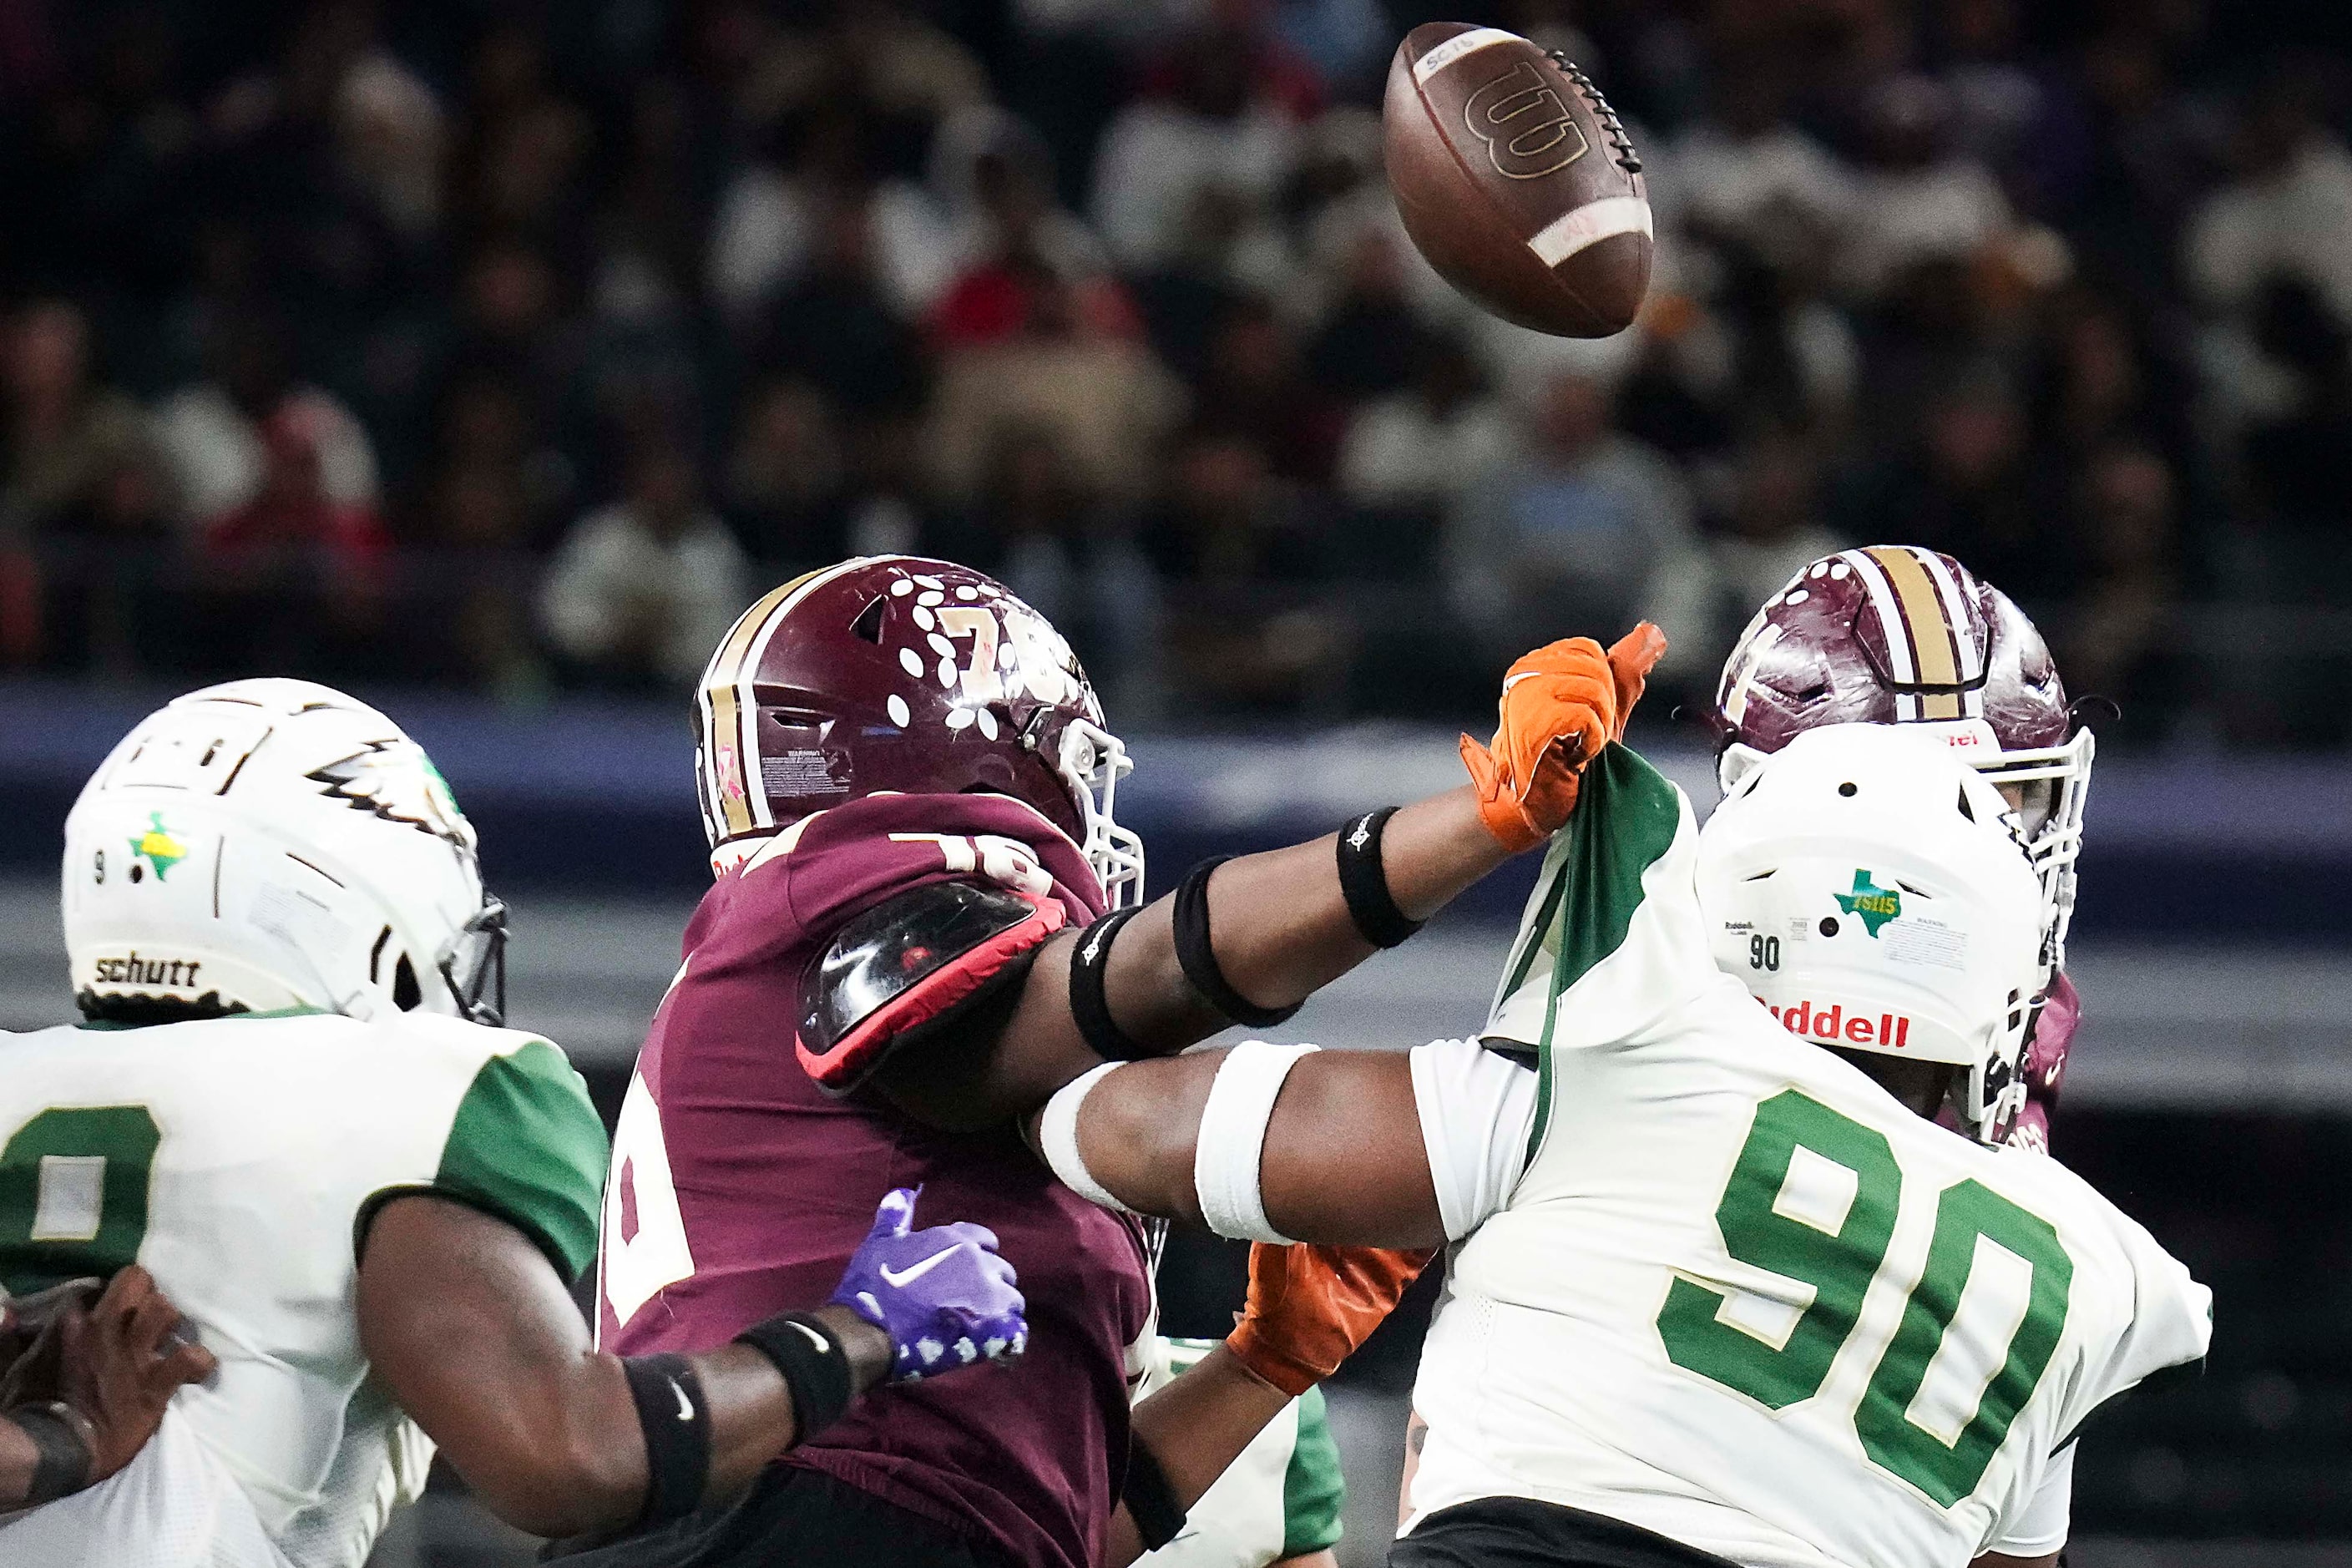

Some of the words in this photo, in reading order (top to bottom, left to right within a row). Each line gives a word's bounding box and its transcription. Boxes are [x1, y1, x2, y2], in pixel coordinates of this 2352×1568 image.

[94, 848, 107, 886] 9
[95, 949, 201, 987] schutt
[1749, 933, 1780, 972] 90
[1652, 1080, 2075, 1512] 90
